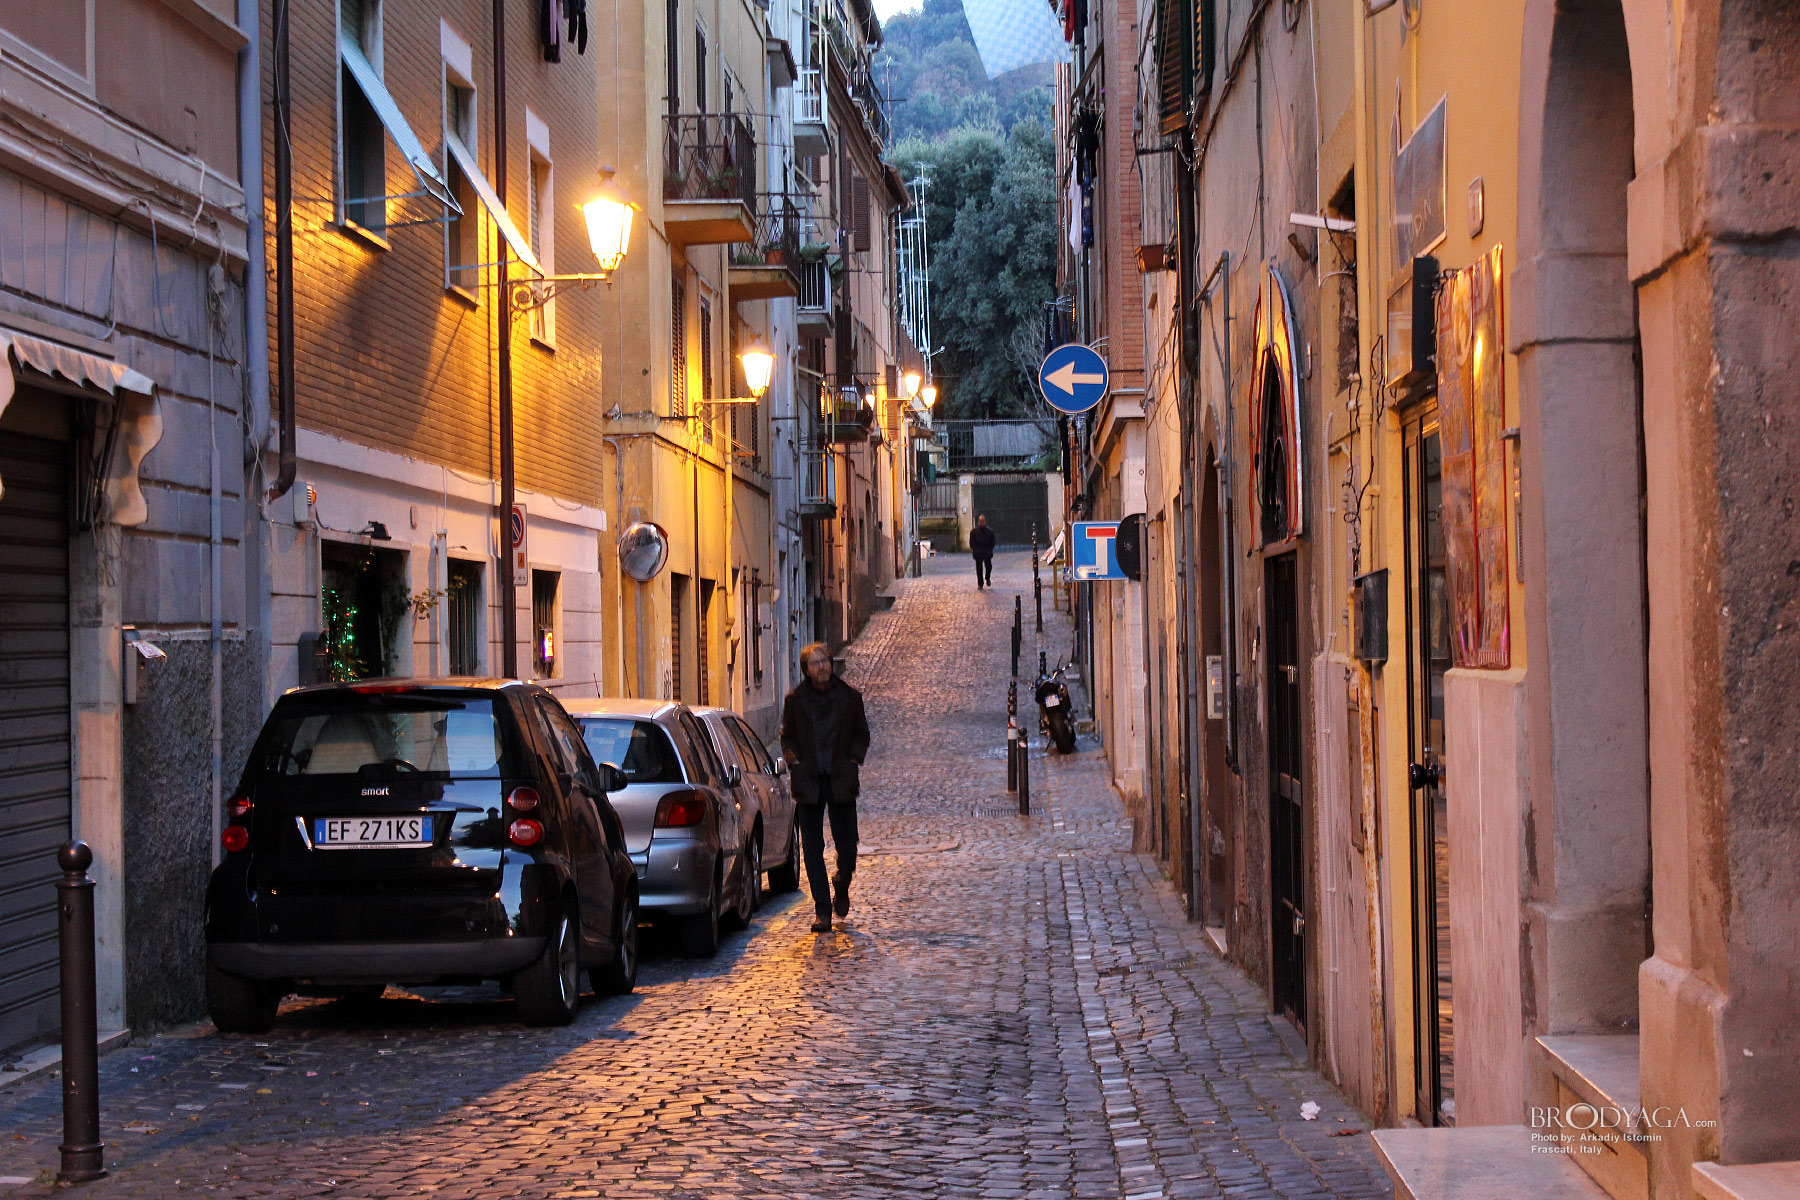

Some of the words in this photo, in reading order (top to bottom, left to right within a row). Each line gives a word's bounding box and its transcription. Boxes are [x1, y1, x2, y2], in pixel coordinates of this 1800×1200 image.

[361, 786, 390, 796] smart
[328, 821, 351, 841] EF
[359, 820, 419, 841] 271KS
